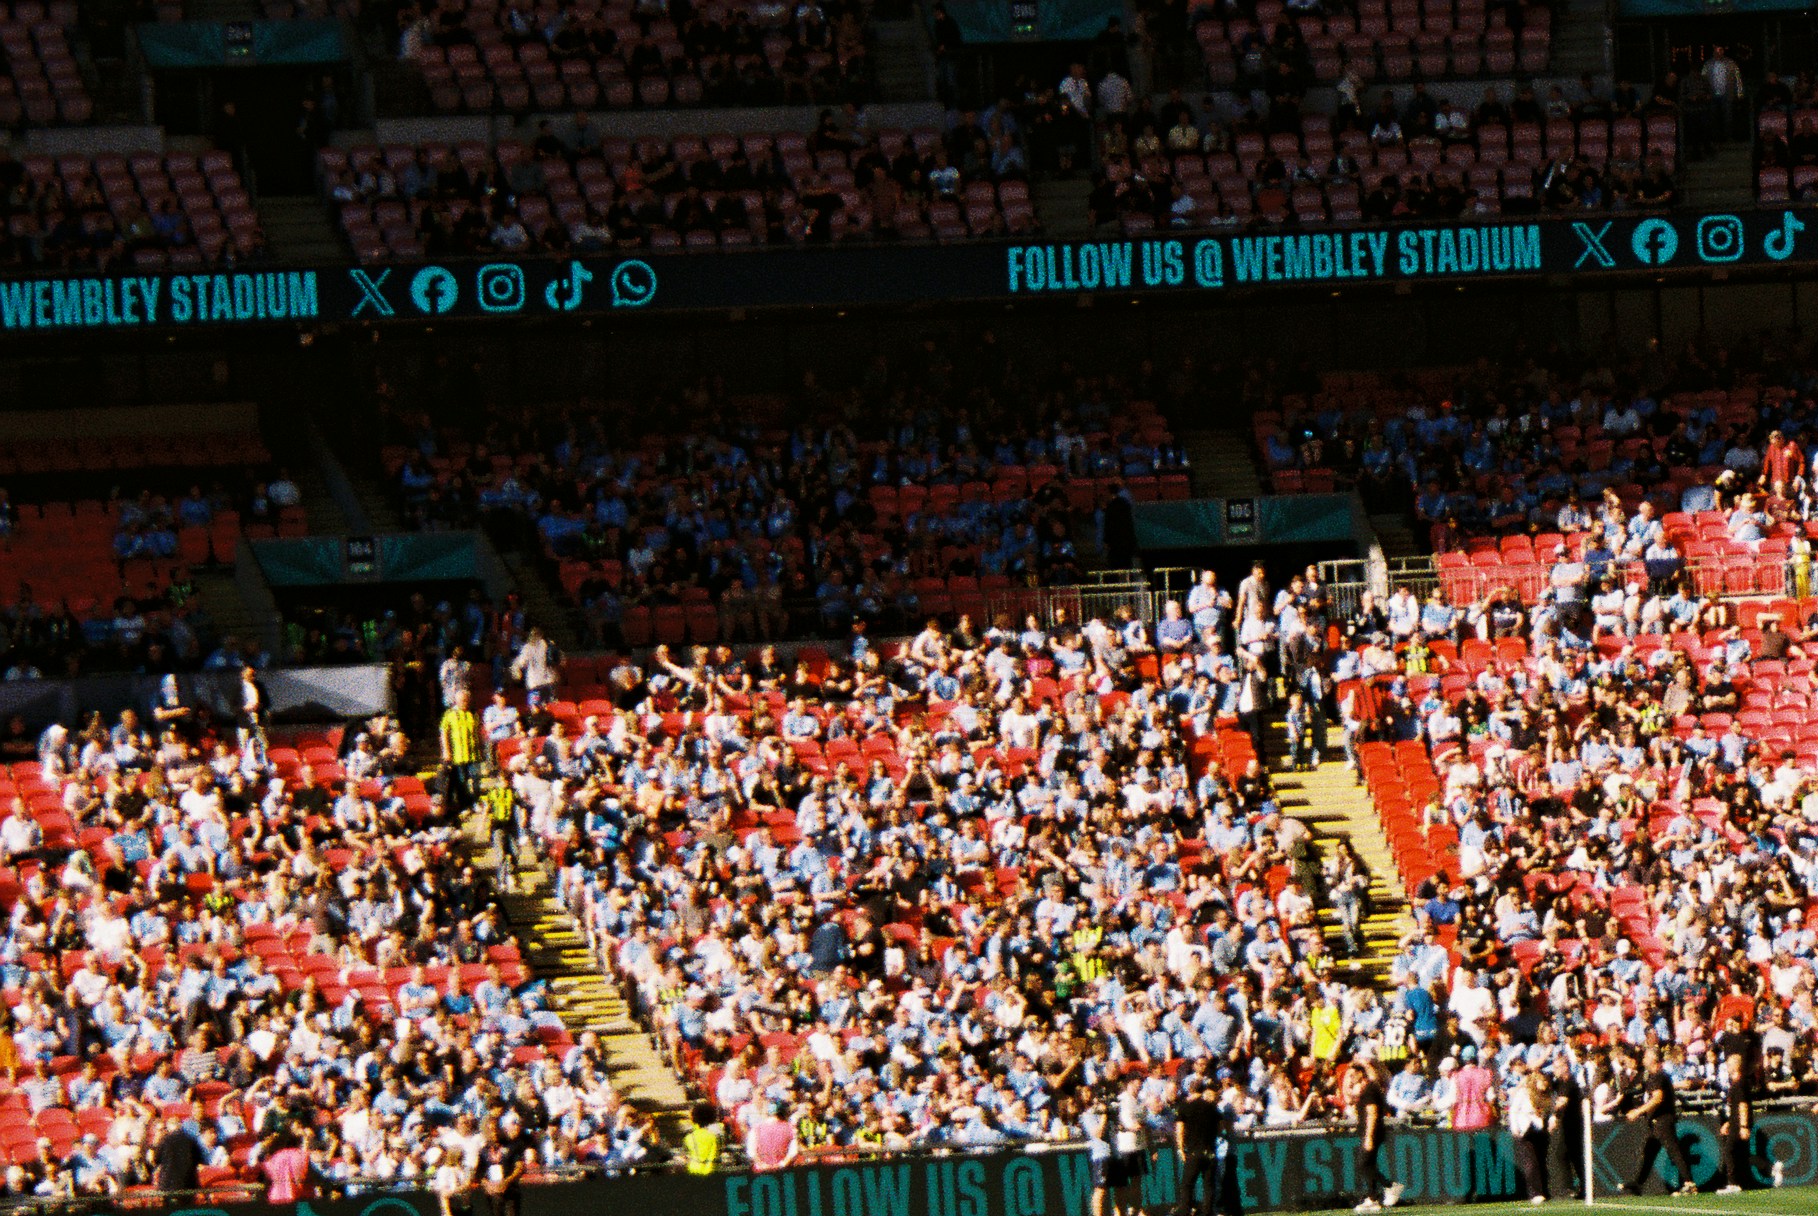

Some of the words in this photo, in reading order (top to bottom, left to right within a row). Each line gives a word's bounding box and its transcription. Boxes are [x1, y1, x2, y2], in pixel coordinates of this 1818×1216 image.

[1008, 242, 1132, 292] FOLLOW
[1142, 240, 1184, 286] US
[1194, 239, 1223, 288] @
[1231, 231, 1388, 282] WEMBLEY
[1398, 225, 1541, 275] STADIUM
[0, 276, 160, 329] WEMBLEY
[170, 271, 318, 321] STADIUM
